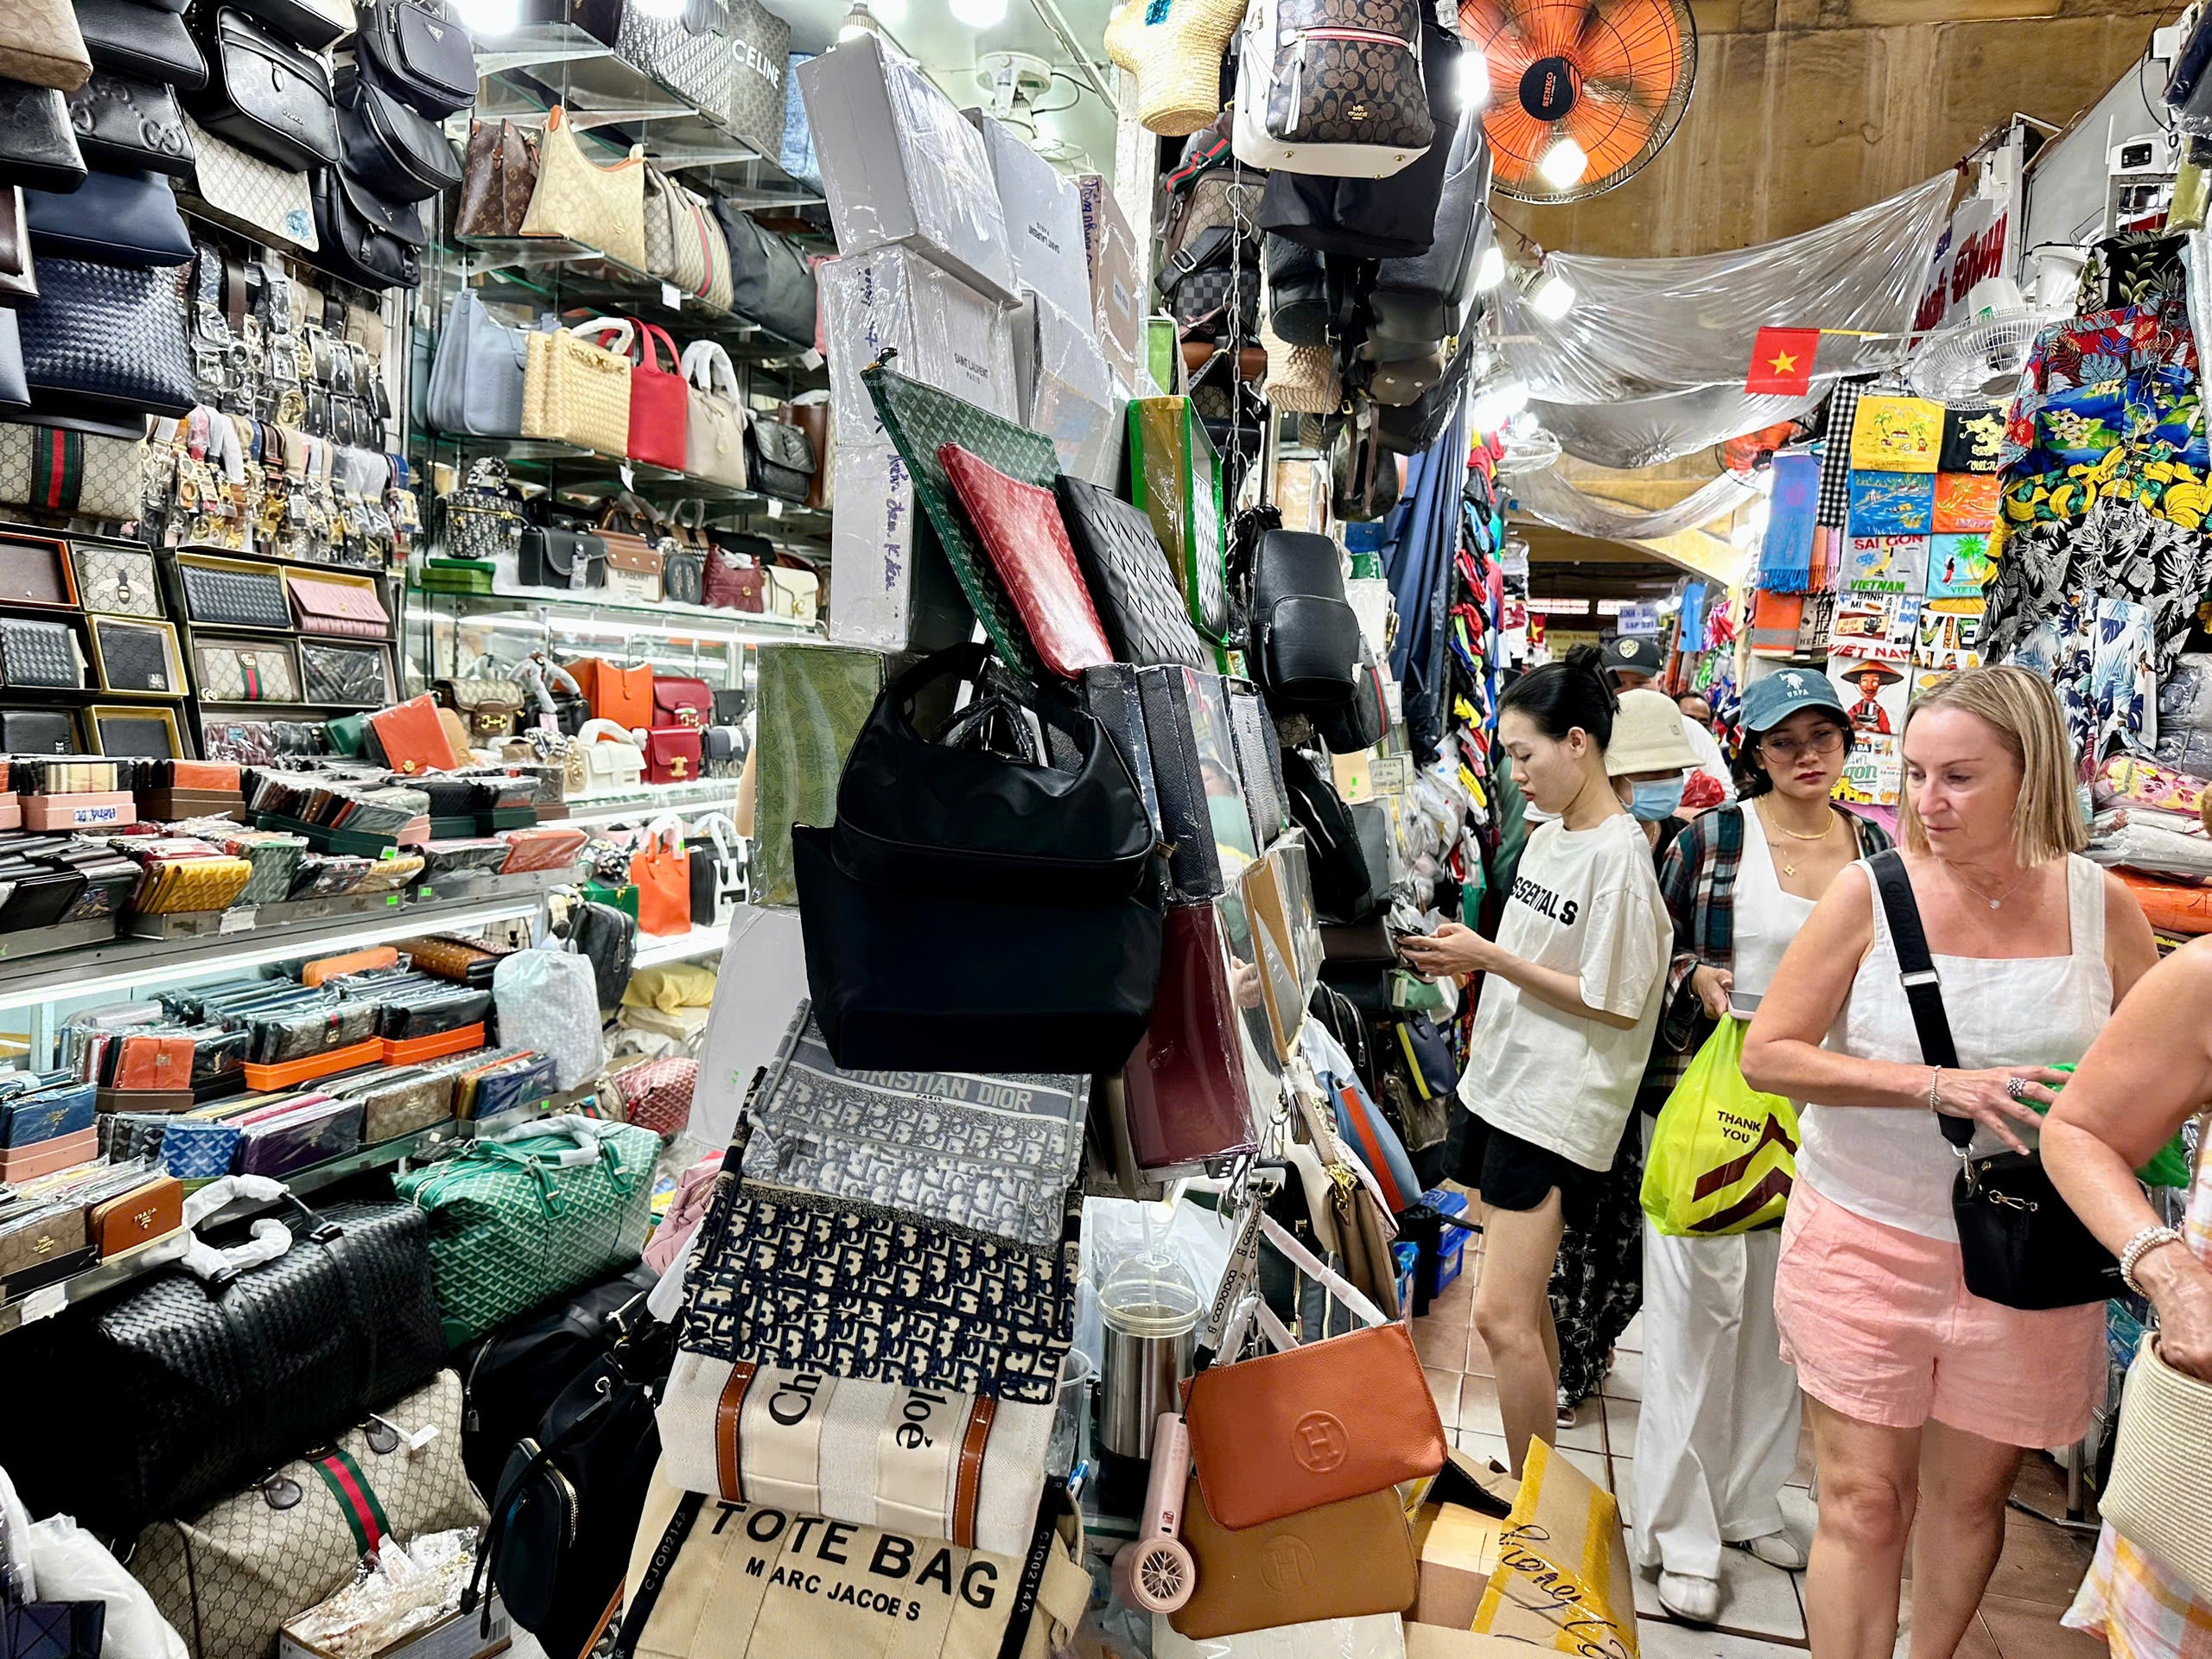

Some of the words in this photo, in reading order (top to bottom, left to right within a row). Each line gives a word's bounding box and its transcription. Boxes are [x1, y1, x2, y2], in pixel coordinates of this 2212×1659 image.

[732, 39, 780, 90] CELINE
[1542, 72, 1553, 106] SENKO
[1850, 580, 1905, 593] VIETNAM
[916, 1093, 942, 1102] PARIS
[977, 1081, 1033, 1113] DIOR
[1717, 1110, 1761, 1132] THANK
[1722, 1127, 1750, 1144] YOU
[711, 1500, 859, 1566] TOTE
[877, 1533, 999, 1610] BAG
[745, 1556, 822, 1594] MARC
[827, 1582, 922, 1622] JACOBS
